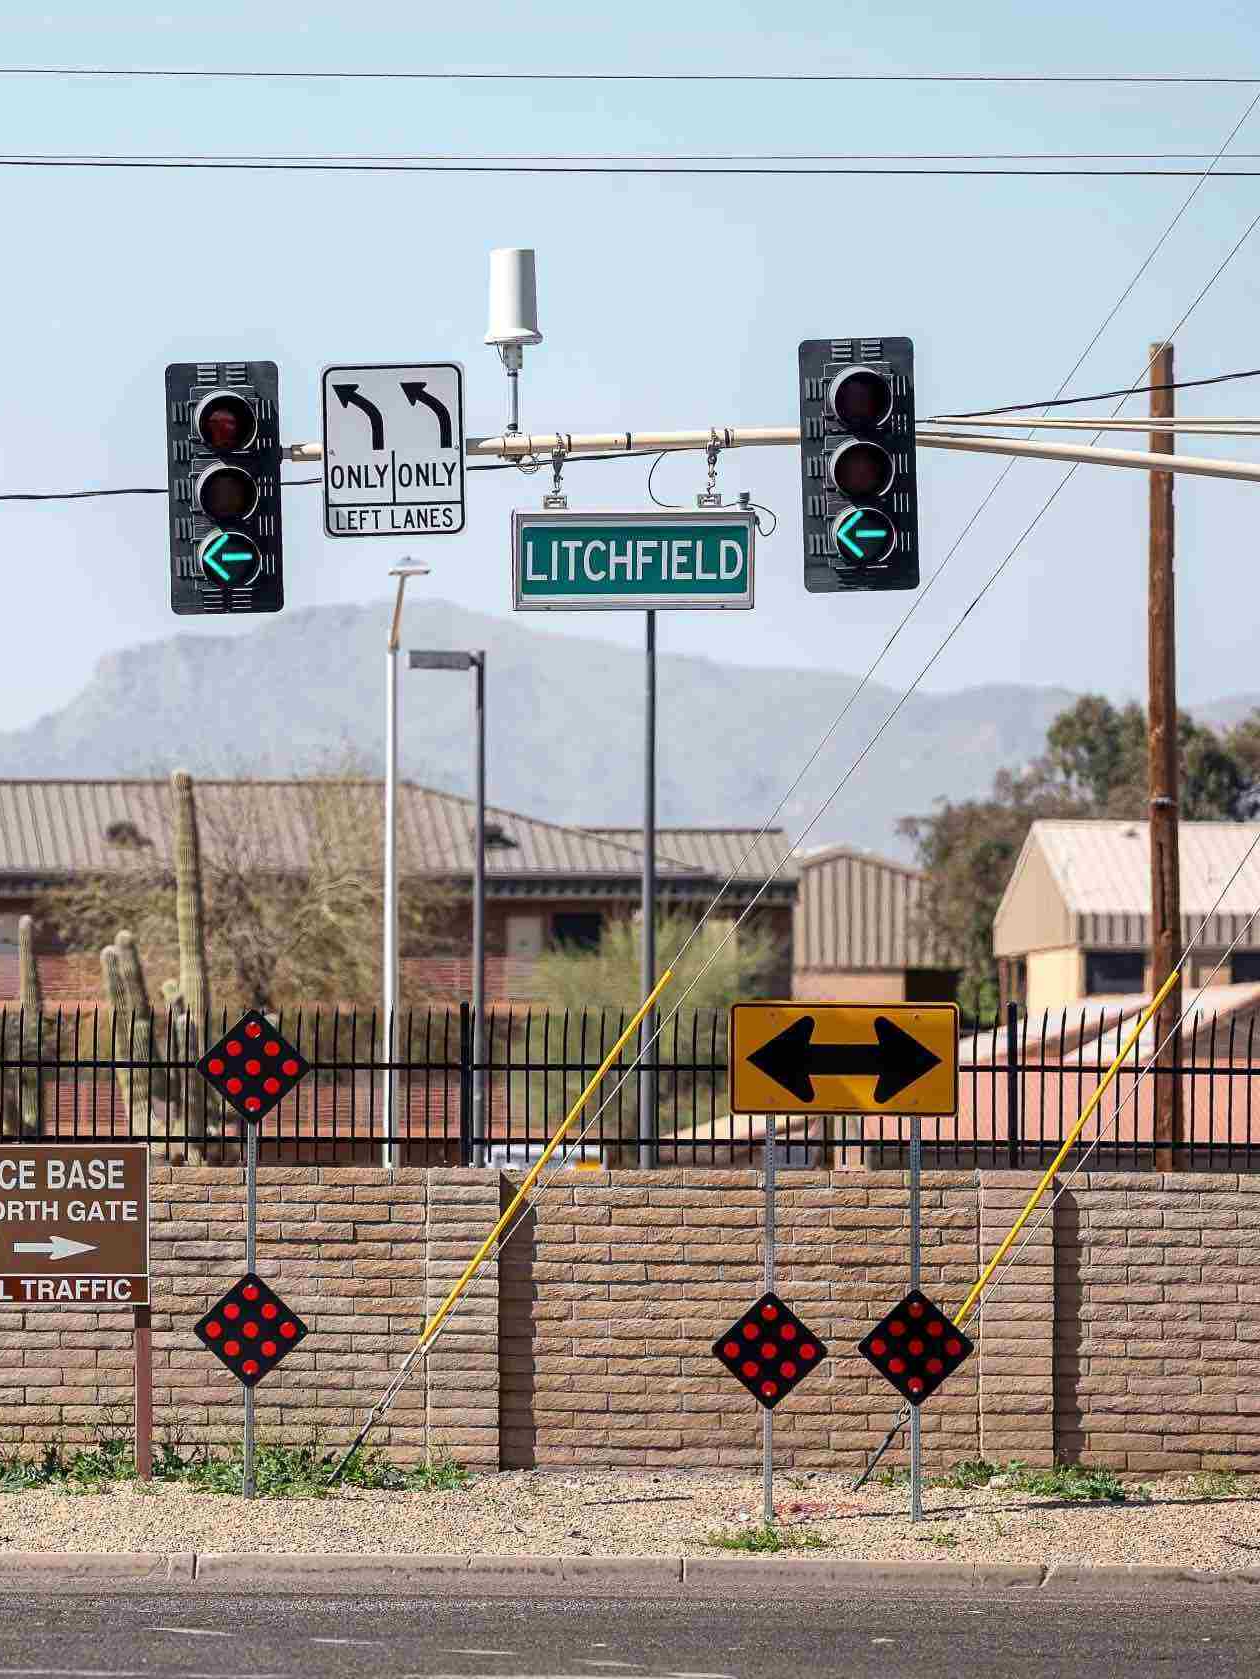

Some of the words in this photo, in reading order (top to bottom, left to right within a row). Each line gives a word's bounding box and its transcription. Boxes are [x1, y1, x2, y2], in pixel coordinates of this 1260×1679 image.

[330, 464, 388, 489] ONLY
[397, 461, 457, 488] ONLY
[335, 510, 380, 531] LEFT
[391, 507, 453, 530] LANES
[526, 540, 744, 581] LITCHFIELD
[46, 1159, 125, 1190] BASE
[66, 1200, 139, 1222] GATE
[19, 1279, 133, 1301] TRAFFIC
